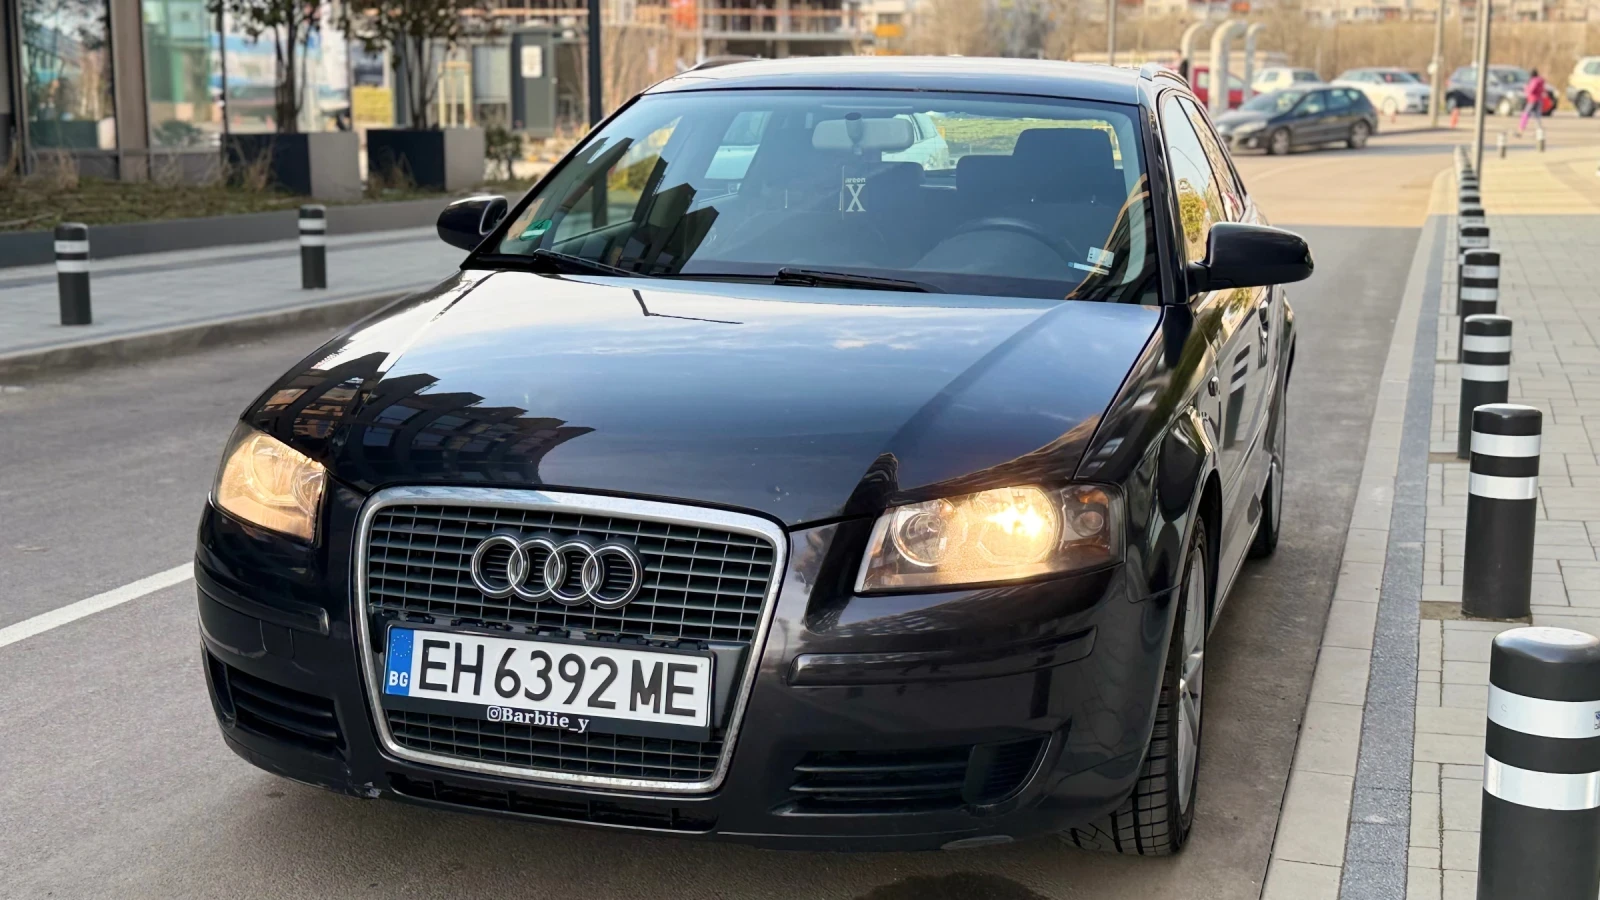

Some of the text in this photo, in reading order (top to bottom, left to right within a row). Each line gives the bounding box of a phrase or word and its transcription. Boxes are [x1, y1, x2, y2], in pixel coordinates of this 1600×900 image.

[845, 183, 867, 212] X
[388, 670, 409, 687] BG
[418, 638, 698, 718] EH 6392 ME
